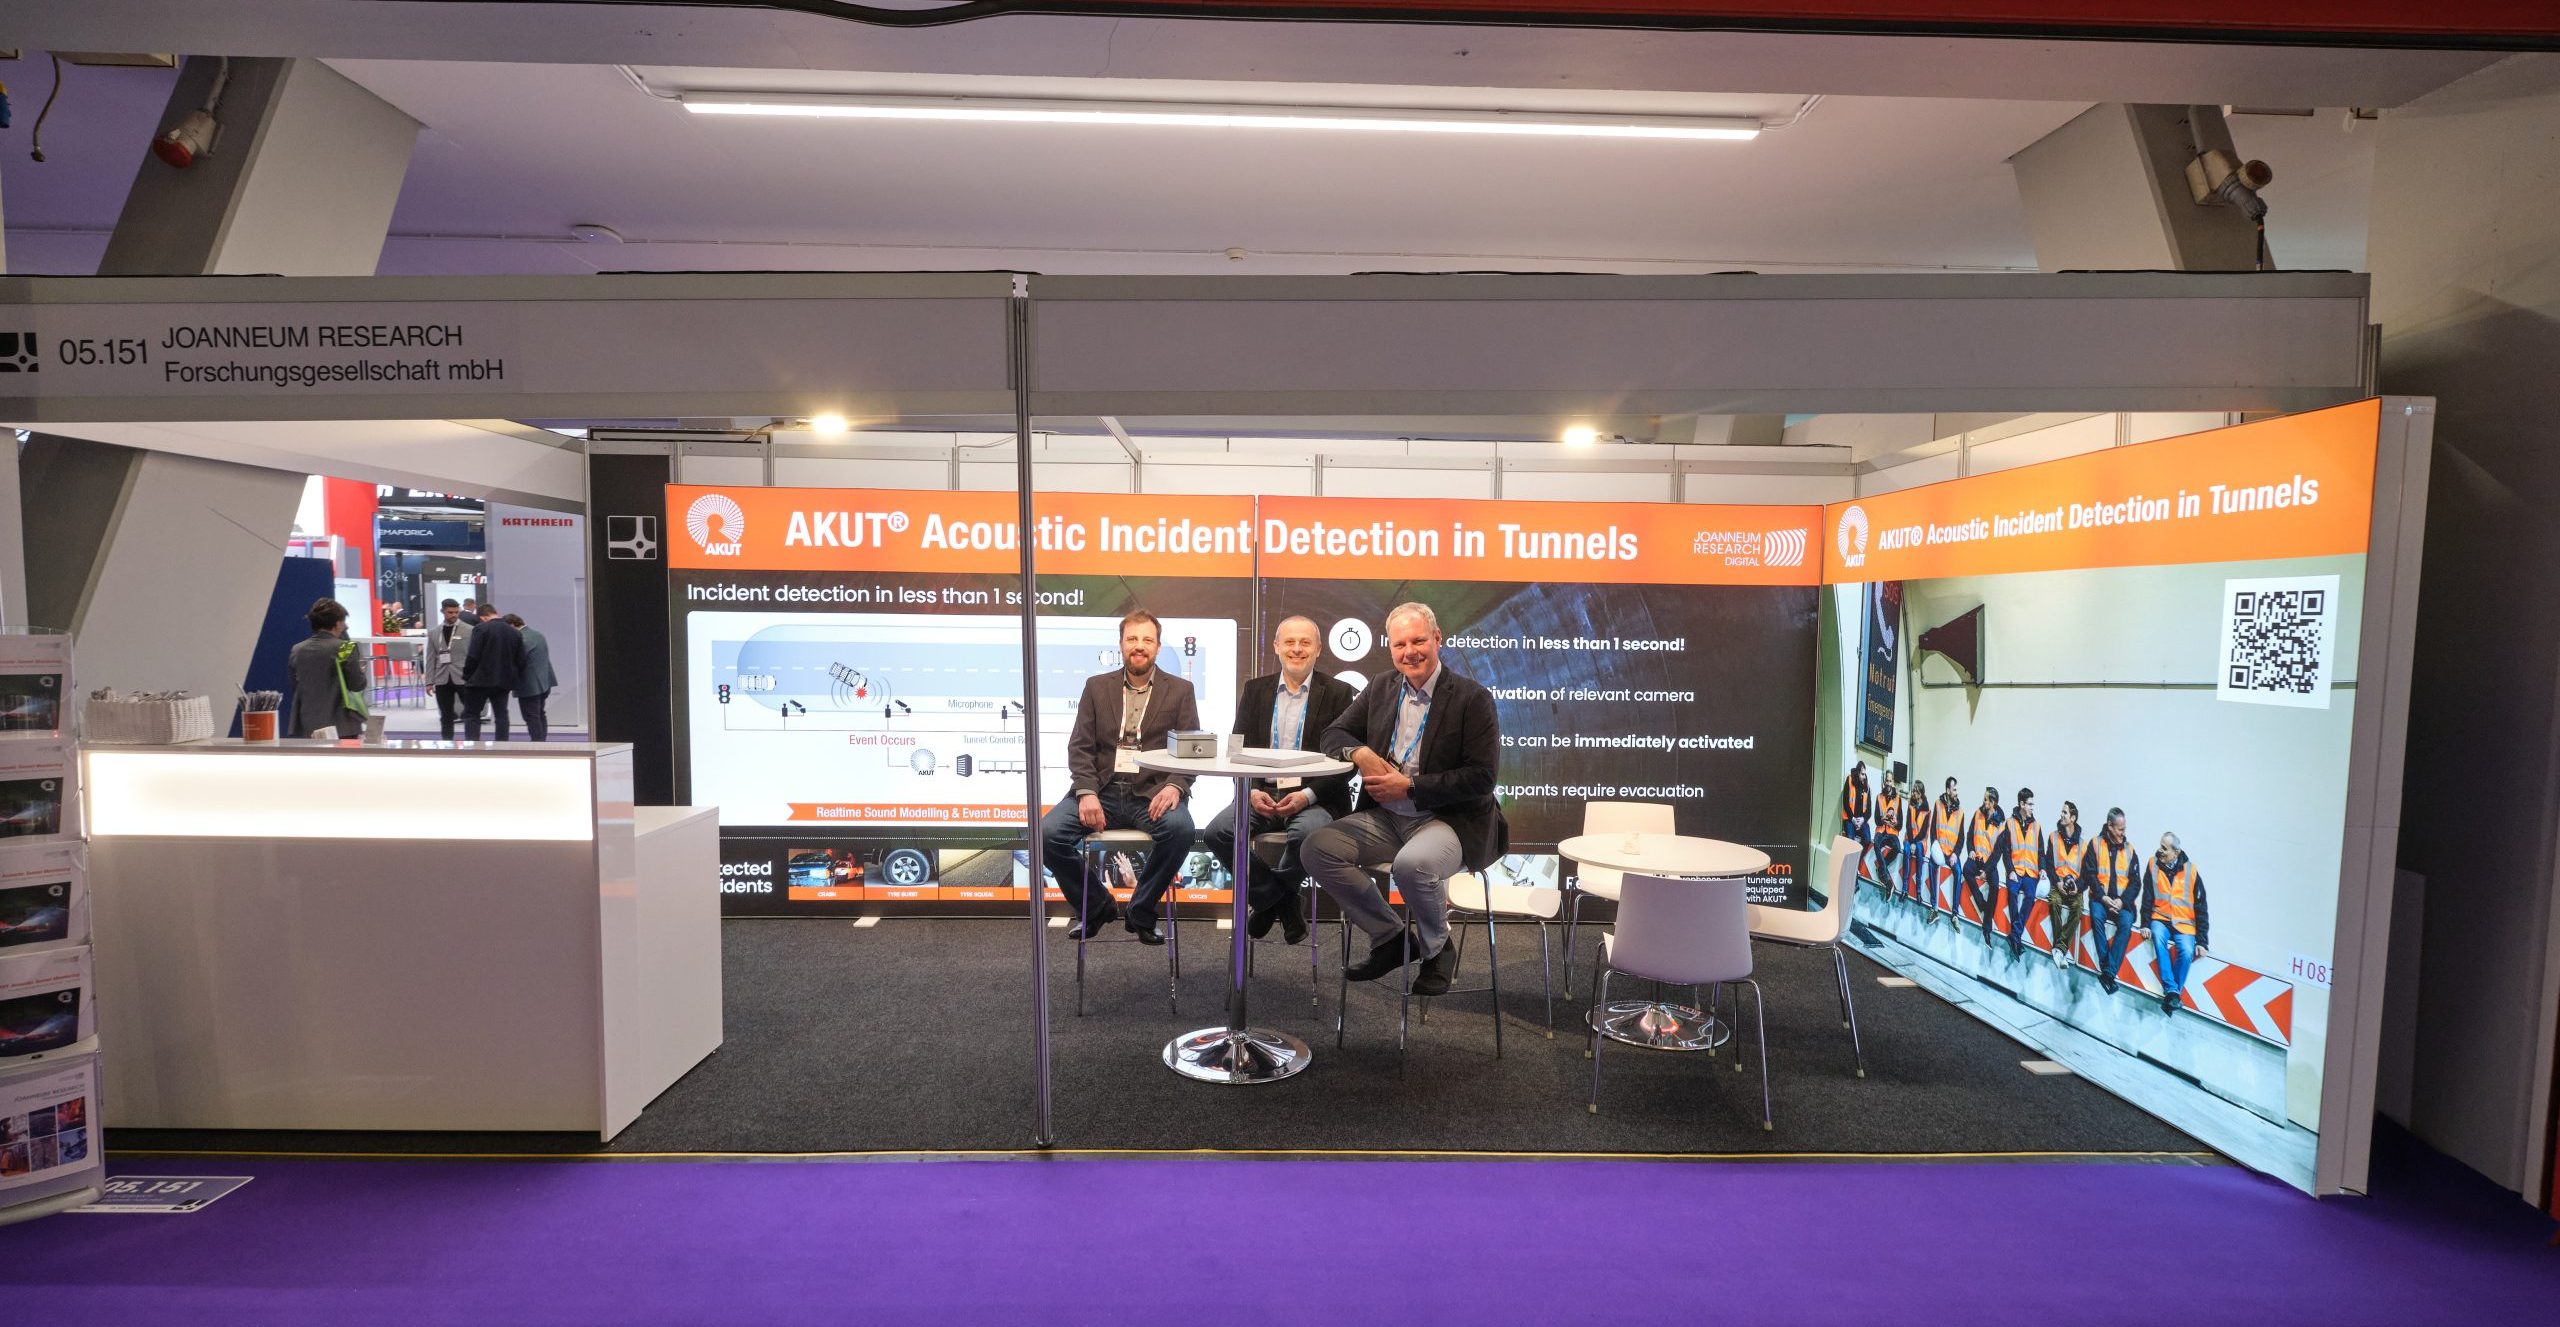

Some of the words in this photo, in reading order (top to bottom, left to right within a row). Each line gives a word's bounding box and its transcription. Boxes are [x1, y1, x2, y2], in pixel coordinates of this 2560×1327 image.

[162, 326, 308, 349] JOANNEUM
[318, 325, 462, 347] RESEARCH
[59, 338, 148, 365] 05.151
[165, 359, 440, 386] Forschungsgesellschaft
[448, 359, 504, 380] mbH
[1926, 516, 1989, 545] Acoustic
[1993, 507, 2064, 538] Incident
[2069, 493, 2169, 529] Detection
[2177, 490, 2200, 518] in
[2209, 474, 2320, 515] Tunnels
[502, 517, 573, 527] KATHREIN
[1100, 516, 1252, 554] Incident
[1264, 519, 1439, 557] Detection
[1453, 523, 1485, 557] in
[1498, 523, 1638, 560] Tunnels
[1693, 531, 1761, 543] JOANNEUM
[704, 543, 742, 556] AKUT
[1693, 543, 1761, 555] RESEARCH
[1725, 557, 1760, 567] DIGITAL
[1844, 553, 1866, 568] AKUT
[687, 584, 770, 602] Incident
[774, 585, 870, 602] detection
[875, 586, 893, 602] in
[898, 587, 937, 604] less
[941, 588, 989, 604] than
[993, 588, 1000, 604] 1
[1446, 634, 1519, 651] detection
[1522, 636, 1537, 651] in
[1539, 636, 1570, 651] less
[1573, 636, 1611, 651] than
[1613, 637, 1620, 651] 1
[1622, 636, 1685, 652] second!
[1869, 663, 1896, 693] Notruf
[1549, 687, 1566, 701] of
[1569, 688, 1631, 702] relevant
[1634, 690, 1694, 702] camera
[947, 699, 994, 710] Microphone
[849, 735, 877, 745] Event
[880, 735, 916, 746] Occurs
[963, 735, 988, 744] Tunnel
[989, 735, 1017, 744] Control
[1518, 736, 1547, 747] can
[1551, 734, 1572, 748] be
[1575, 734, 1675, 752] immediately
[1679, 736, 1753, 750] activated
[1494, 784, 1558, 799] cupants
[1563, 784, 1616, 800] require
[1620, 784, 1704, 798] evacuation
[816, 806, 861, 818] Realtime
[864, 807, 897, 819] Sound
[899, 807, 950, 820] Modelling
[951, 808, 960, 818] &
[962, 808, 991, 819] Event
[1766, 863, 1792, 875] km
[1747, 876, 1777, 885] tunnels
[1778, 876, 1793, 885] are
[1745, 885, 1785, 895] equipped
[2291, 956, 2303, 976] H
